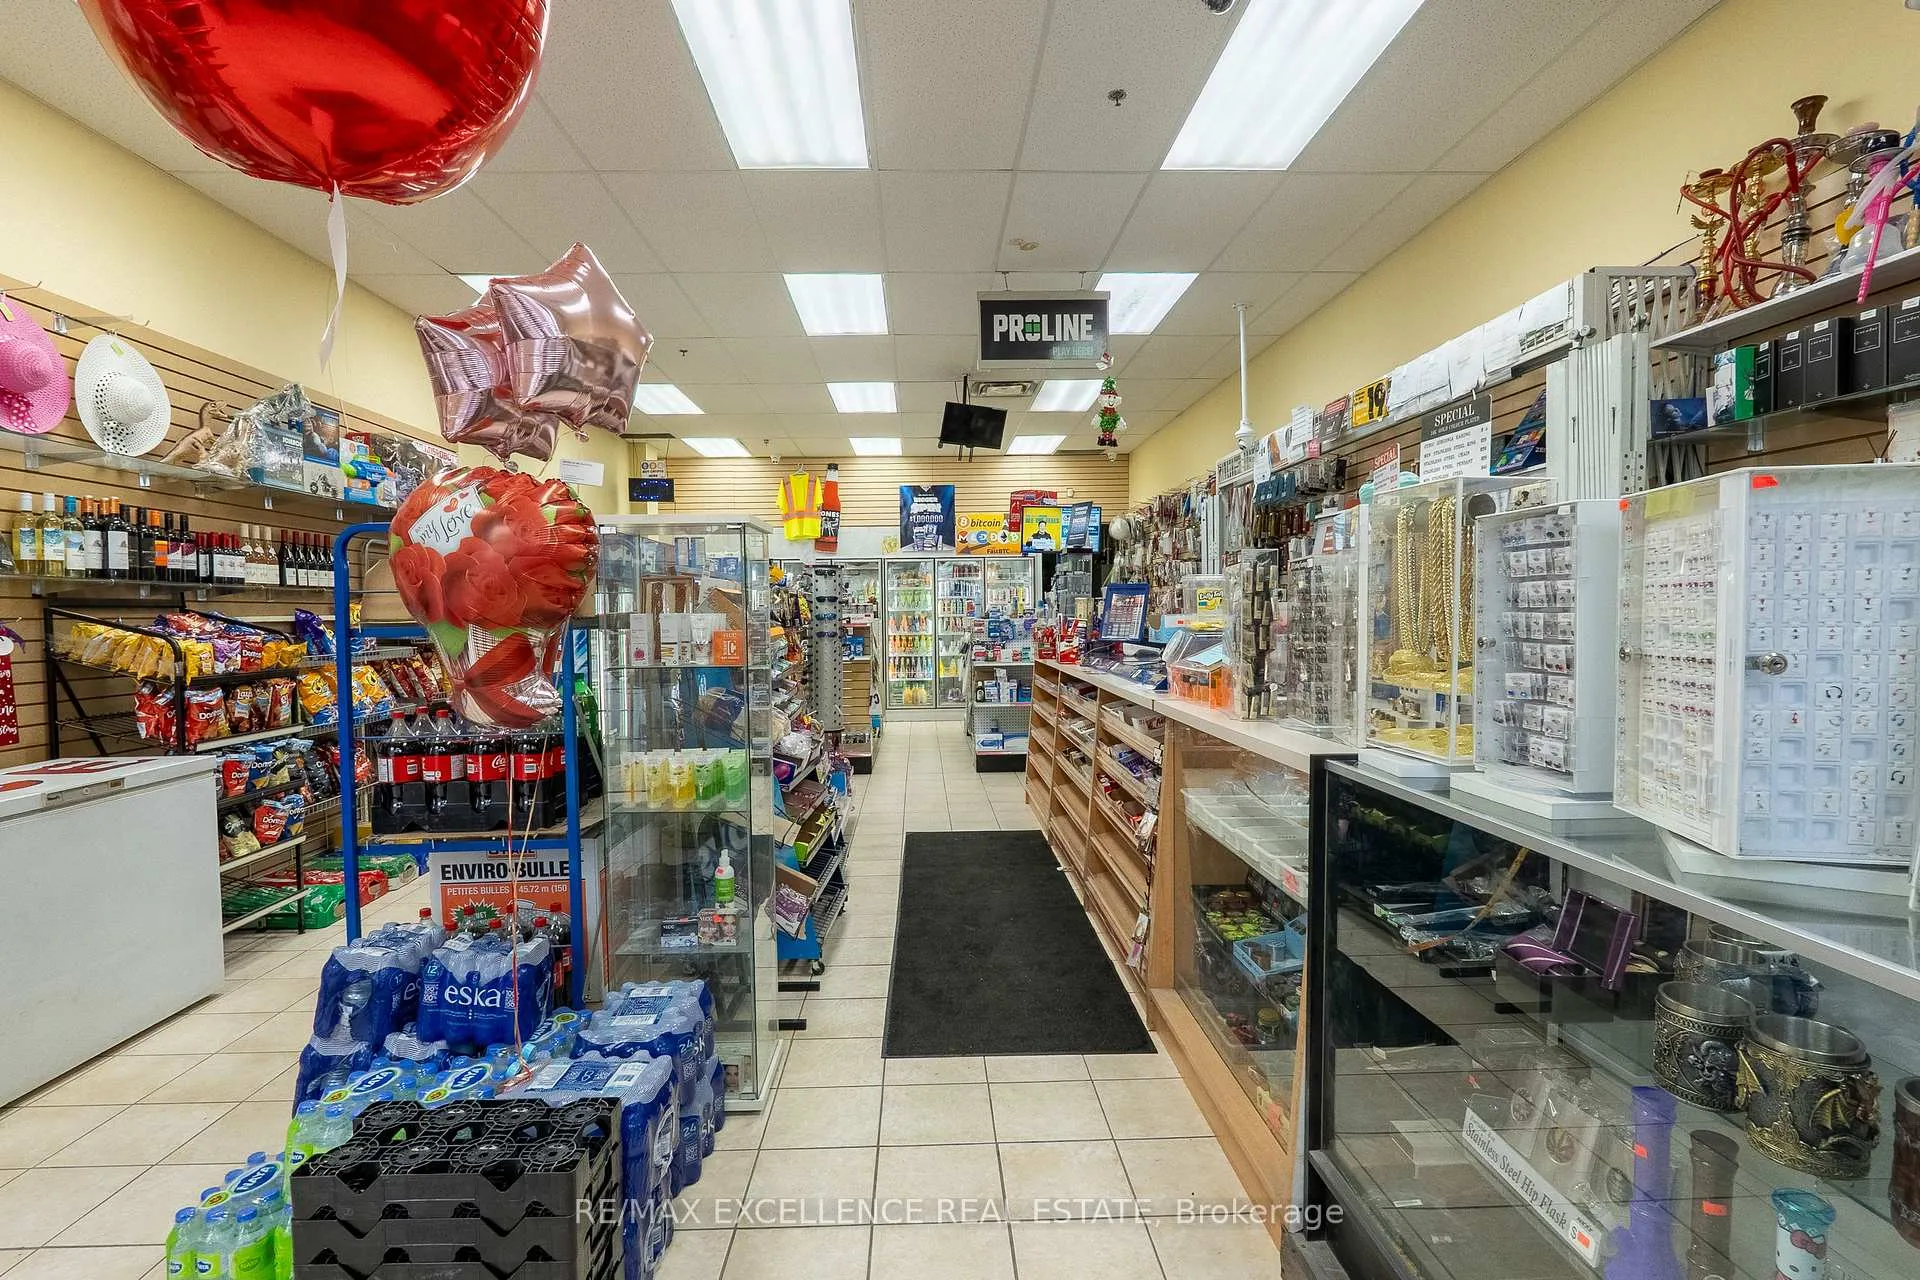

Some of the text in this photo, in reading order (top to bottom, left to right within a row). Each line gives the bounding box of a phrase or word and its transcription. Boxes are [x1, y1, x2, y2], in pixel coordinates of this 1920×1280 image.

[993, 313, 1093, 342] PROLINE
[1368, 382, 1386, 420] 19
[1434, 403, 1475, 427] SPECIAL
[1373, 447, 1398, 469] SPECIAL
[440, 503, 473, 543] Love
[820, 510, 840, 518] ONES
[970, 518, 1001, 528] bitcoin
[447, 885, 510, 896] PETITES BULLES
[518, 884, 540, 894] 45.72
[444, 985, 501, 1008] eska
[679, 1041, 694, 1053] 24
[360, 1069, 393, 1092] NAYA
[455, 1066, 489, 1089] NAYA
[682, 1126, 697, 1138] 24
[236, 1165, 273, 1191] NAYA
[1465, 1122, 1567, 1230] Stainless Steel Hip Flask
